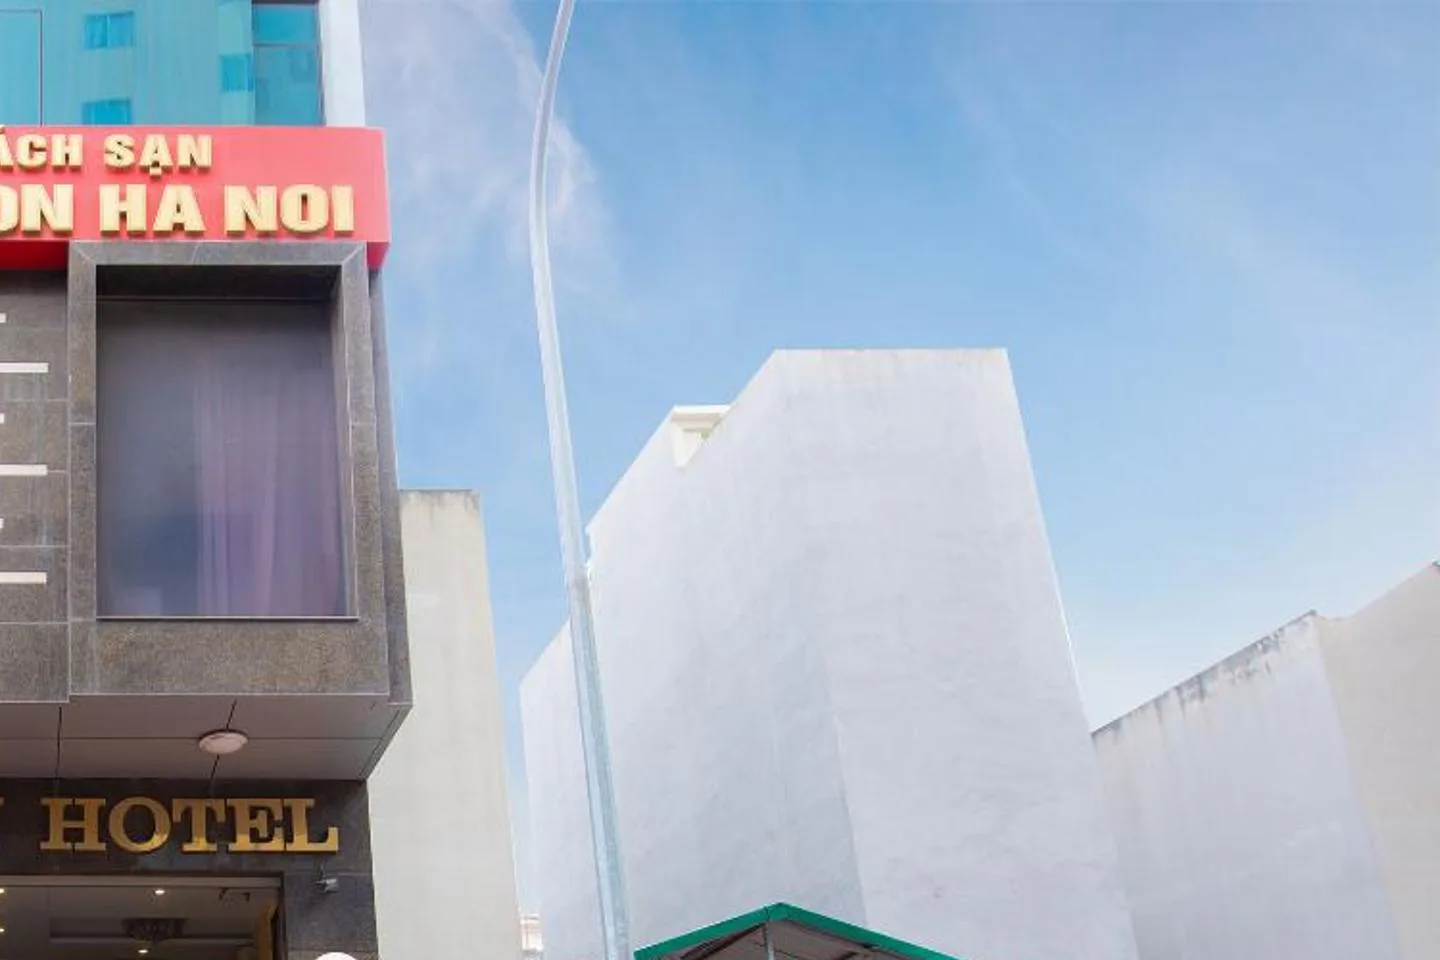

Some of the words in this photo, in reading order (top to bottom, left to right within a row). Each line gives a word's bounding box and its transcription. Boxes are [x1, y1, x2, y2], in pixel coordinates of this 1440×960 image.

[104, 133, 214, 178] SẠN
[99, 184, 206, 233] HA
[224, 184, 356, 234] NOI
[40, 797, 340, 854] HOTEL
